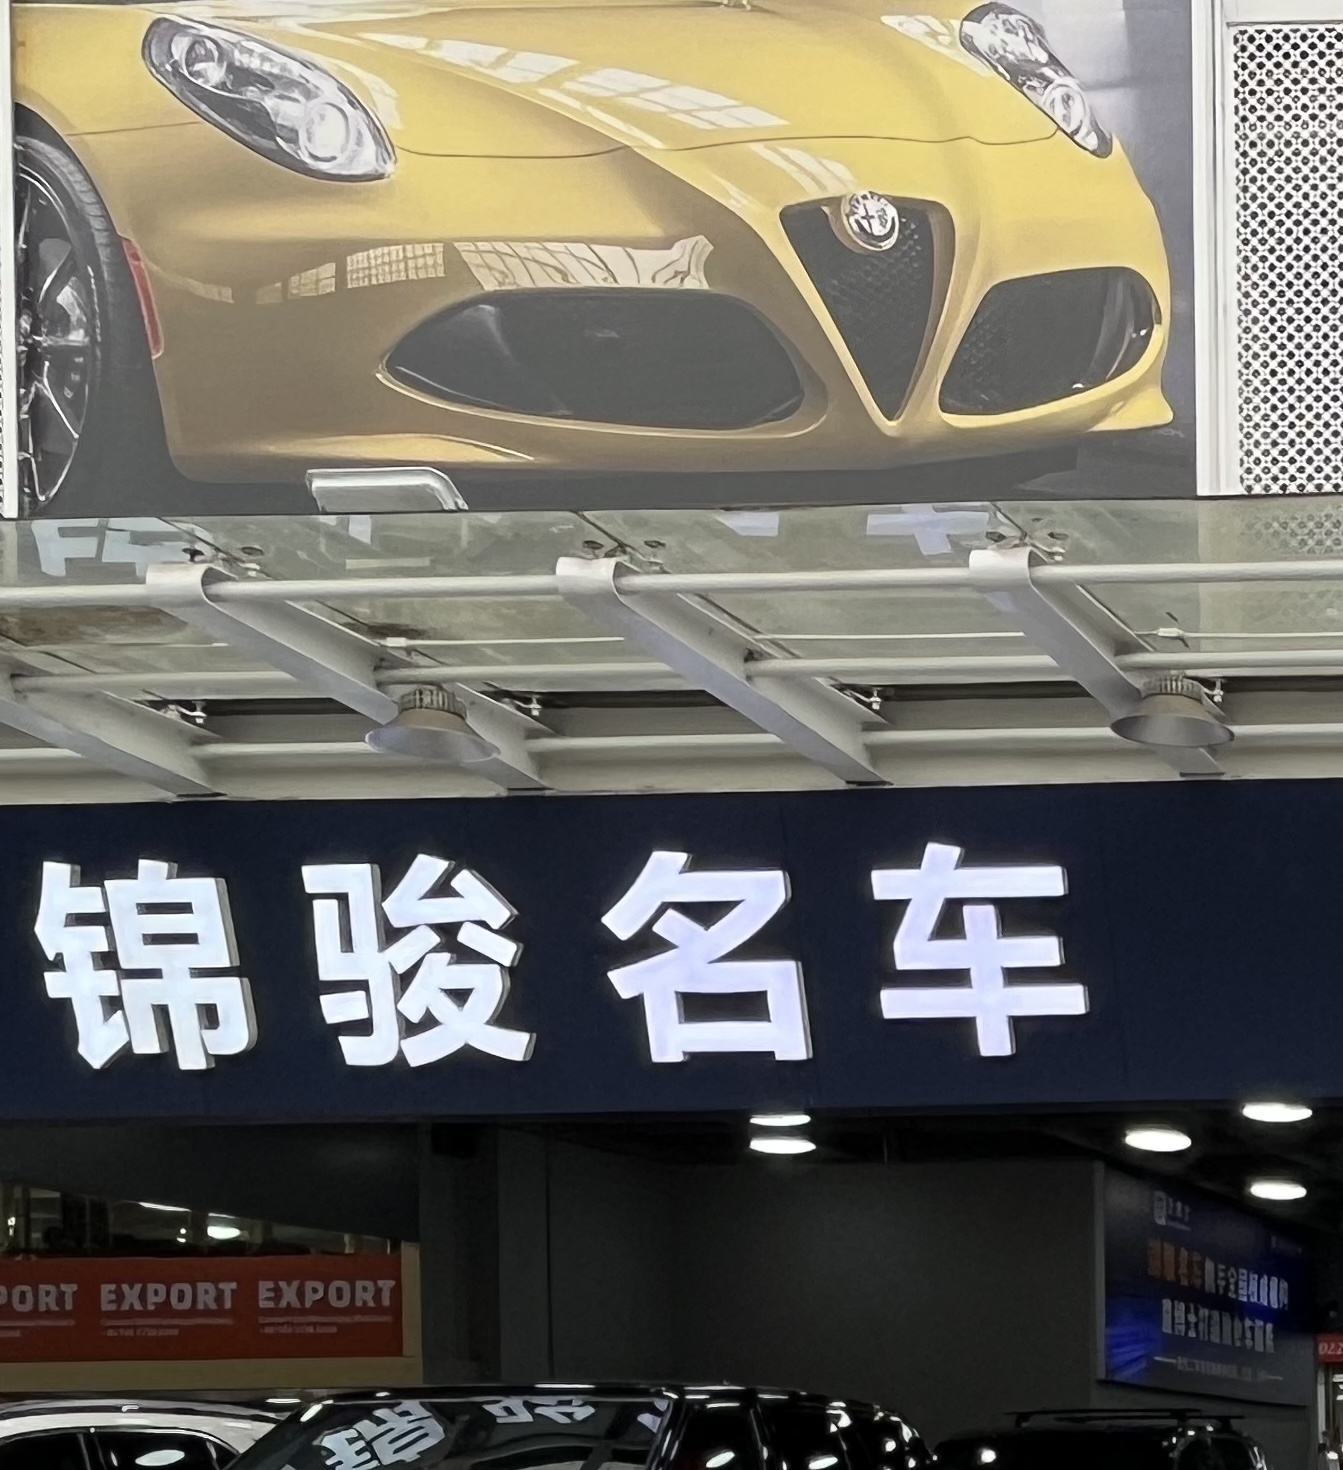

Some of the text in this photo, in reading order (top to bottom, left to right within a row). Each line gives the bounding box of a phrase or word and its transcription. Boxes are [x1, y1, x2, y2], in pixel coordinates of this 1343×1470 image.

[33, 841, 1090, 1071] 锦骏名车
[100, 1282, 237, 1311] EXPORT
[258, 1279, 396, 1309] EXPORT
